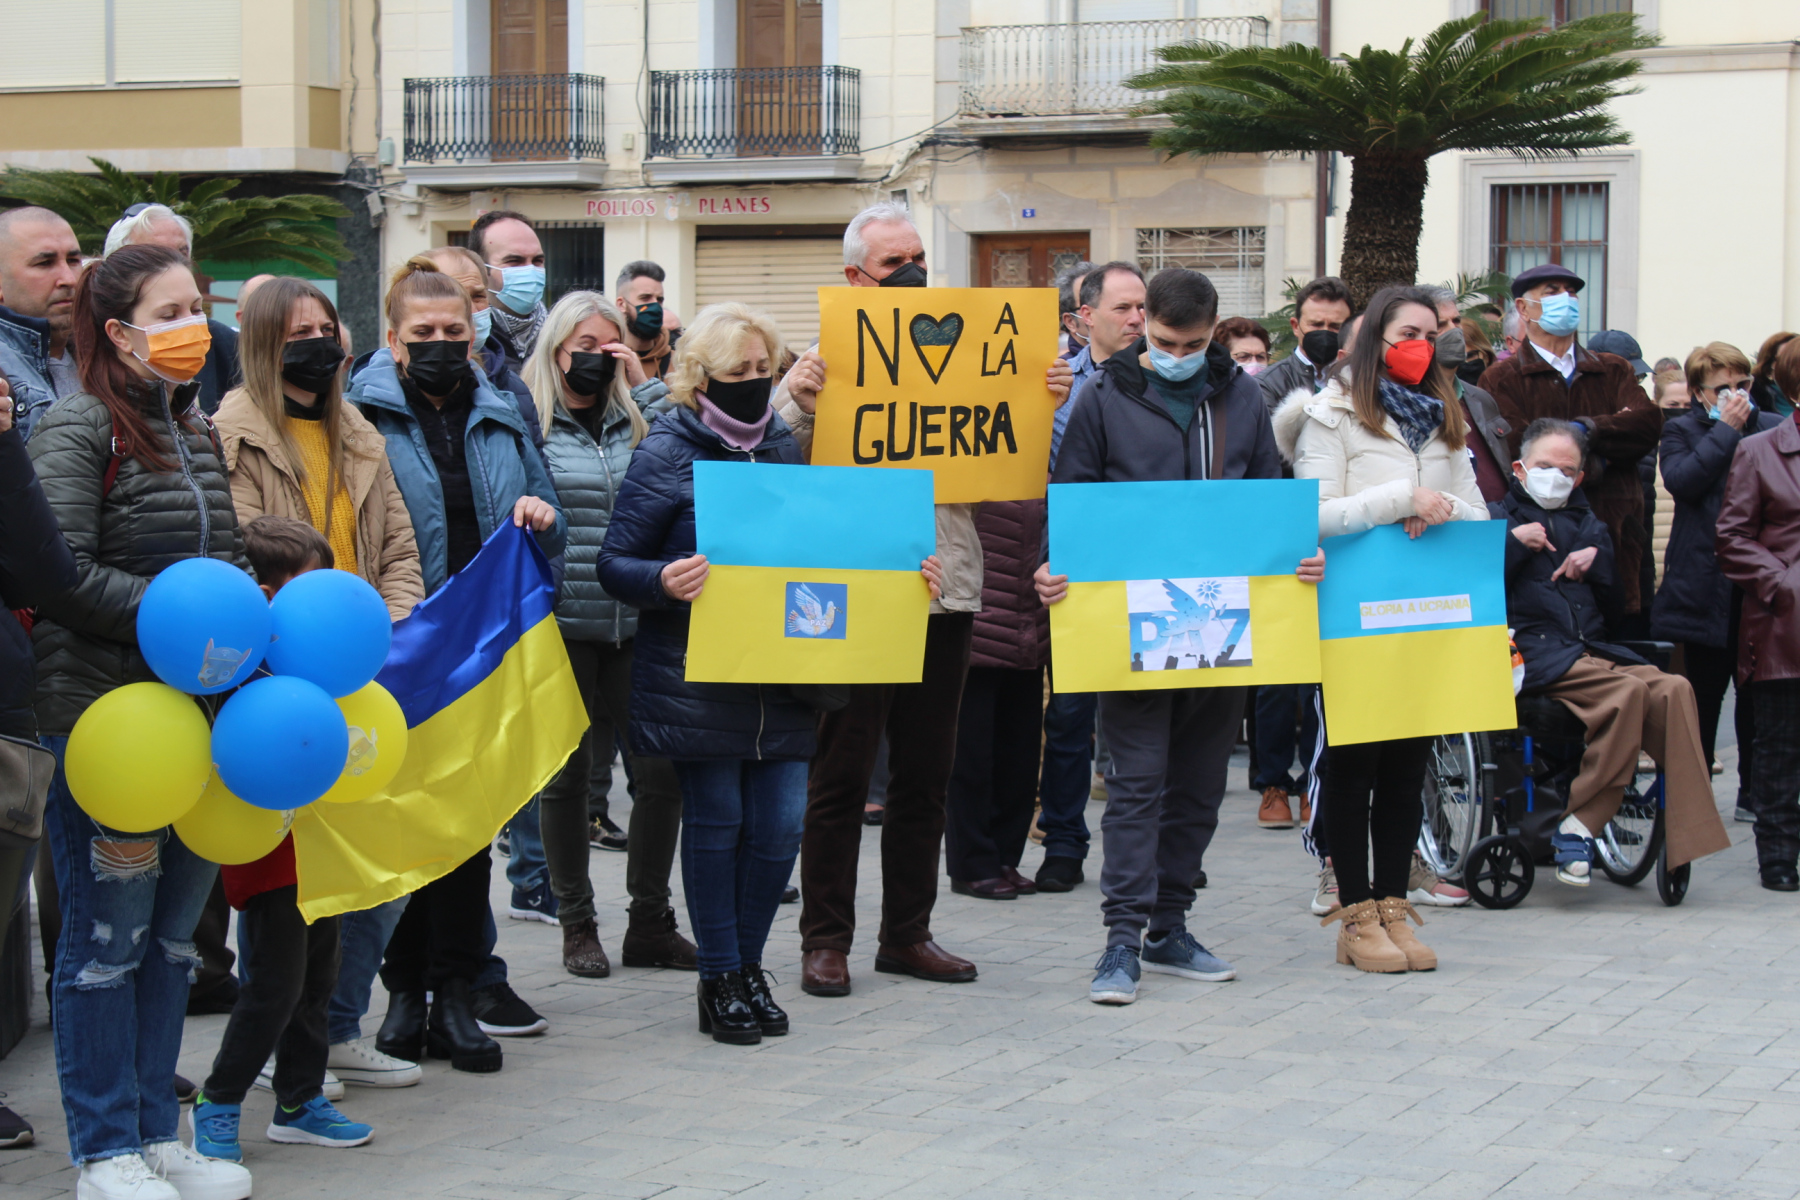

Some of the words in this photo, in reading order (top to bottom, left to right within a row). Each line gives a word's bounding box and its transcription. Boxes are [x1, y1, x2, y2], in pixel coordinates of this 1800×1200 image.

[586, 199, 656, 216] POLLOS
[699, 197, 771, 214] PLANES
[994, 302, 1019, 335] A
[981, 339, 1018, 377] LA
[853, 401, 1018, 465] GUERRA
[1360, 603, 1404, 617] GLORIA
[1407, 602, 1416, 613] A
[1419, 598, 1471, 612] UCRANIA
